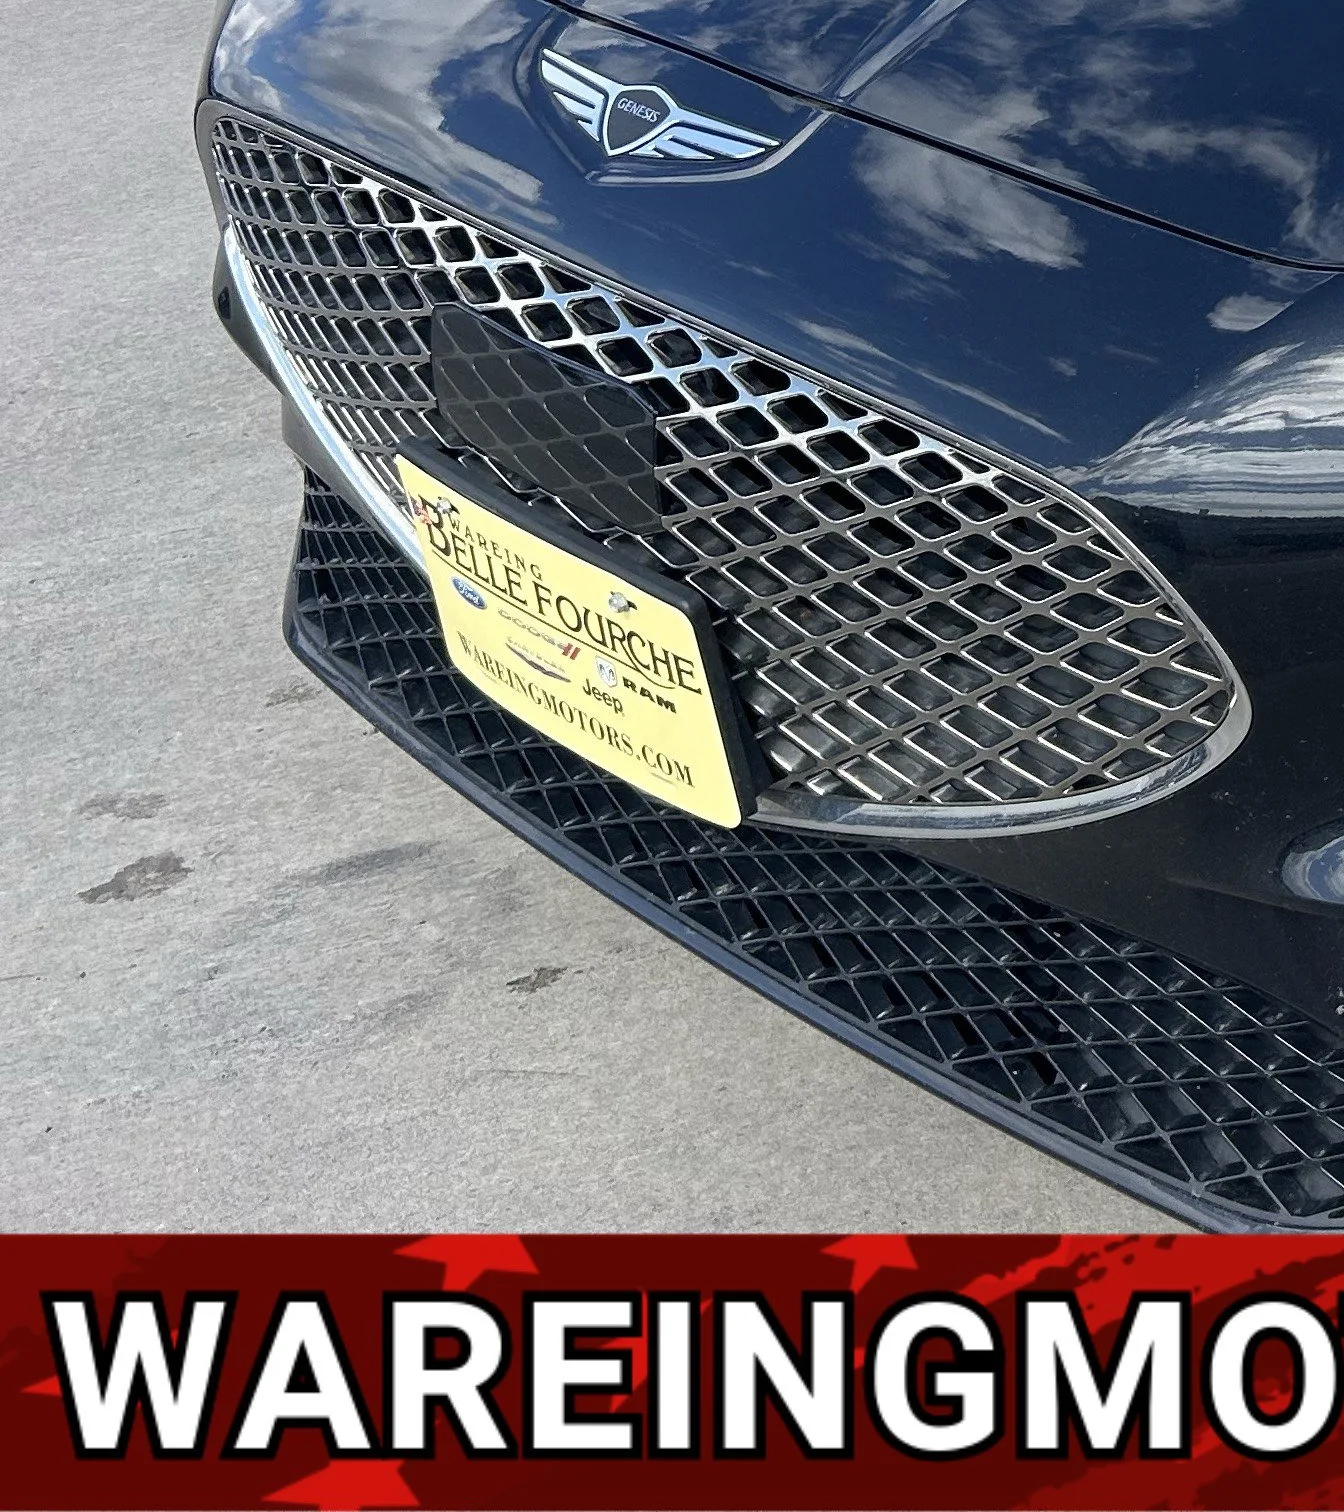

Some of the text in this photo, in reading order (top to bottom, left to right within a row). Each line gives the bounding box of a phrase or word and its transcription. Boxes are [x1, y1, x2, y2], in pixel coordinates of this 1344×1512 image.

[617, 97, 661, 123] GENESIS
[448, 513, 543, 581] WAREING
[417, 493, 703, 696] BELLE FOURCHE
[457, 631, 696, 788] WAREINGMOTORS.COM
[582, 678, 624, 714] Jeep
[622, 676, 677, 714] RAM
